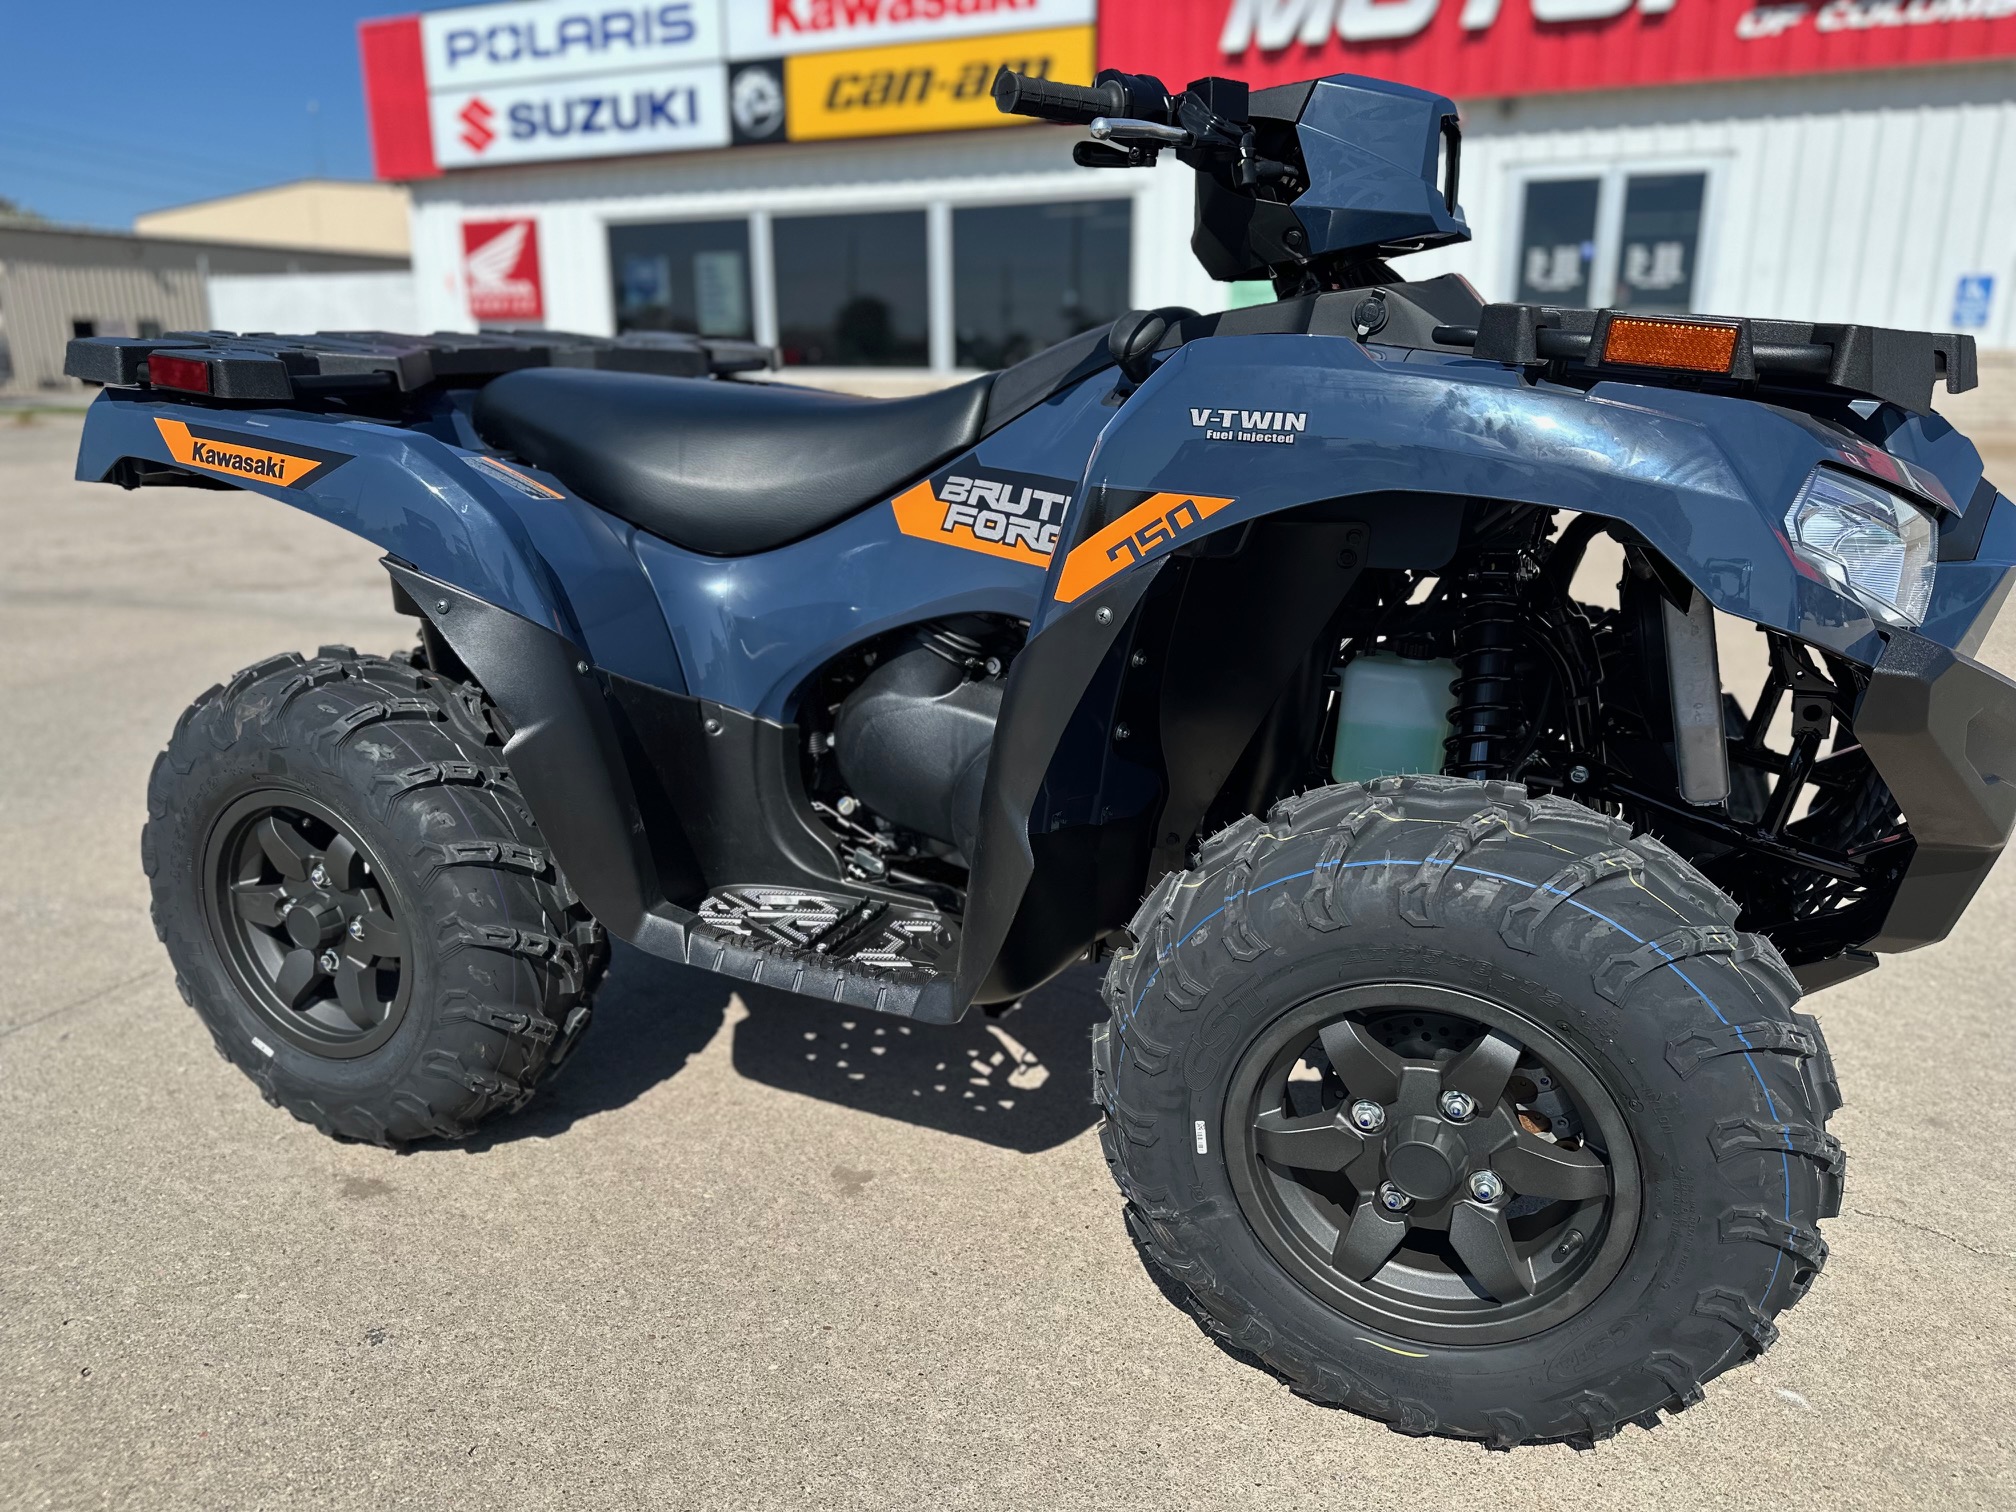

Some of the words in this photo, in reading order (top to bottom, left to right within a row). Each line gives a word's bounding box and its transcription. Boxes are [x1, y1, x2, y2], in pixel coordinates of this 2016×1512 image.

[446, 4, 695, 68] POLARIS
[770, 0, 1038, 36] Kawas
[508, 87, 697, 140] SUZUKI
[1189, 408, 1307, 431] V-TWIN
[1206, 429, 1234, 440] Fuel
[1237, 431, 1295, 443] Injected
[191, 441, 286, 480] Kawasaki
[938, 475, 1072, 524] BRUT
[943, 503, 1062, 554] FORC
[1105, 498, 1204, 563] 750
[1181, 971, 1268, 1092] CST
